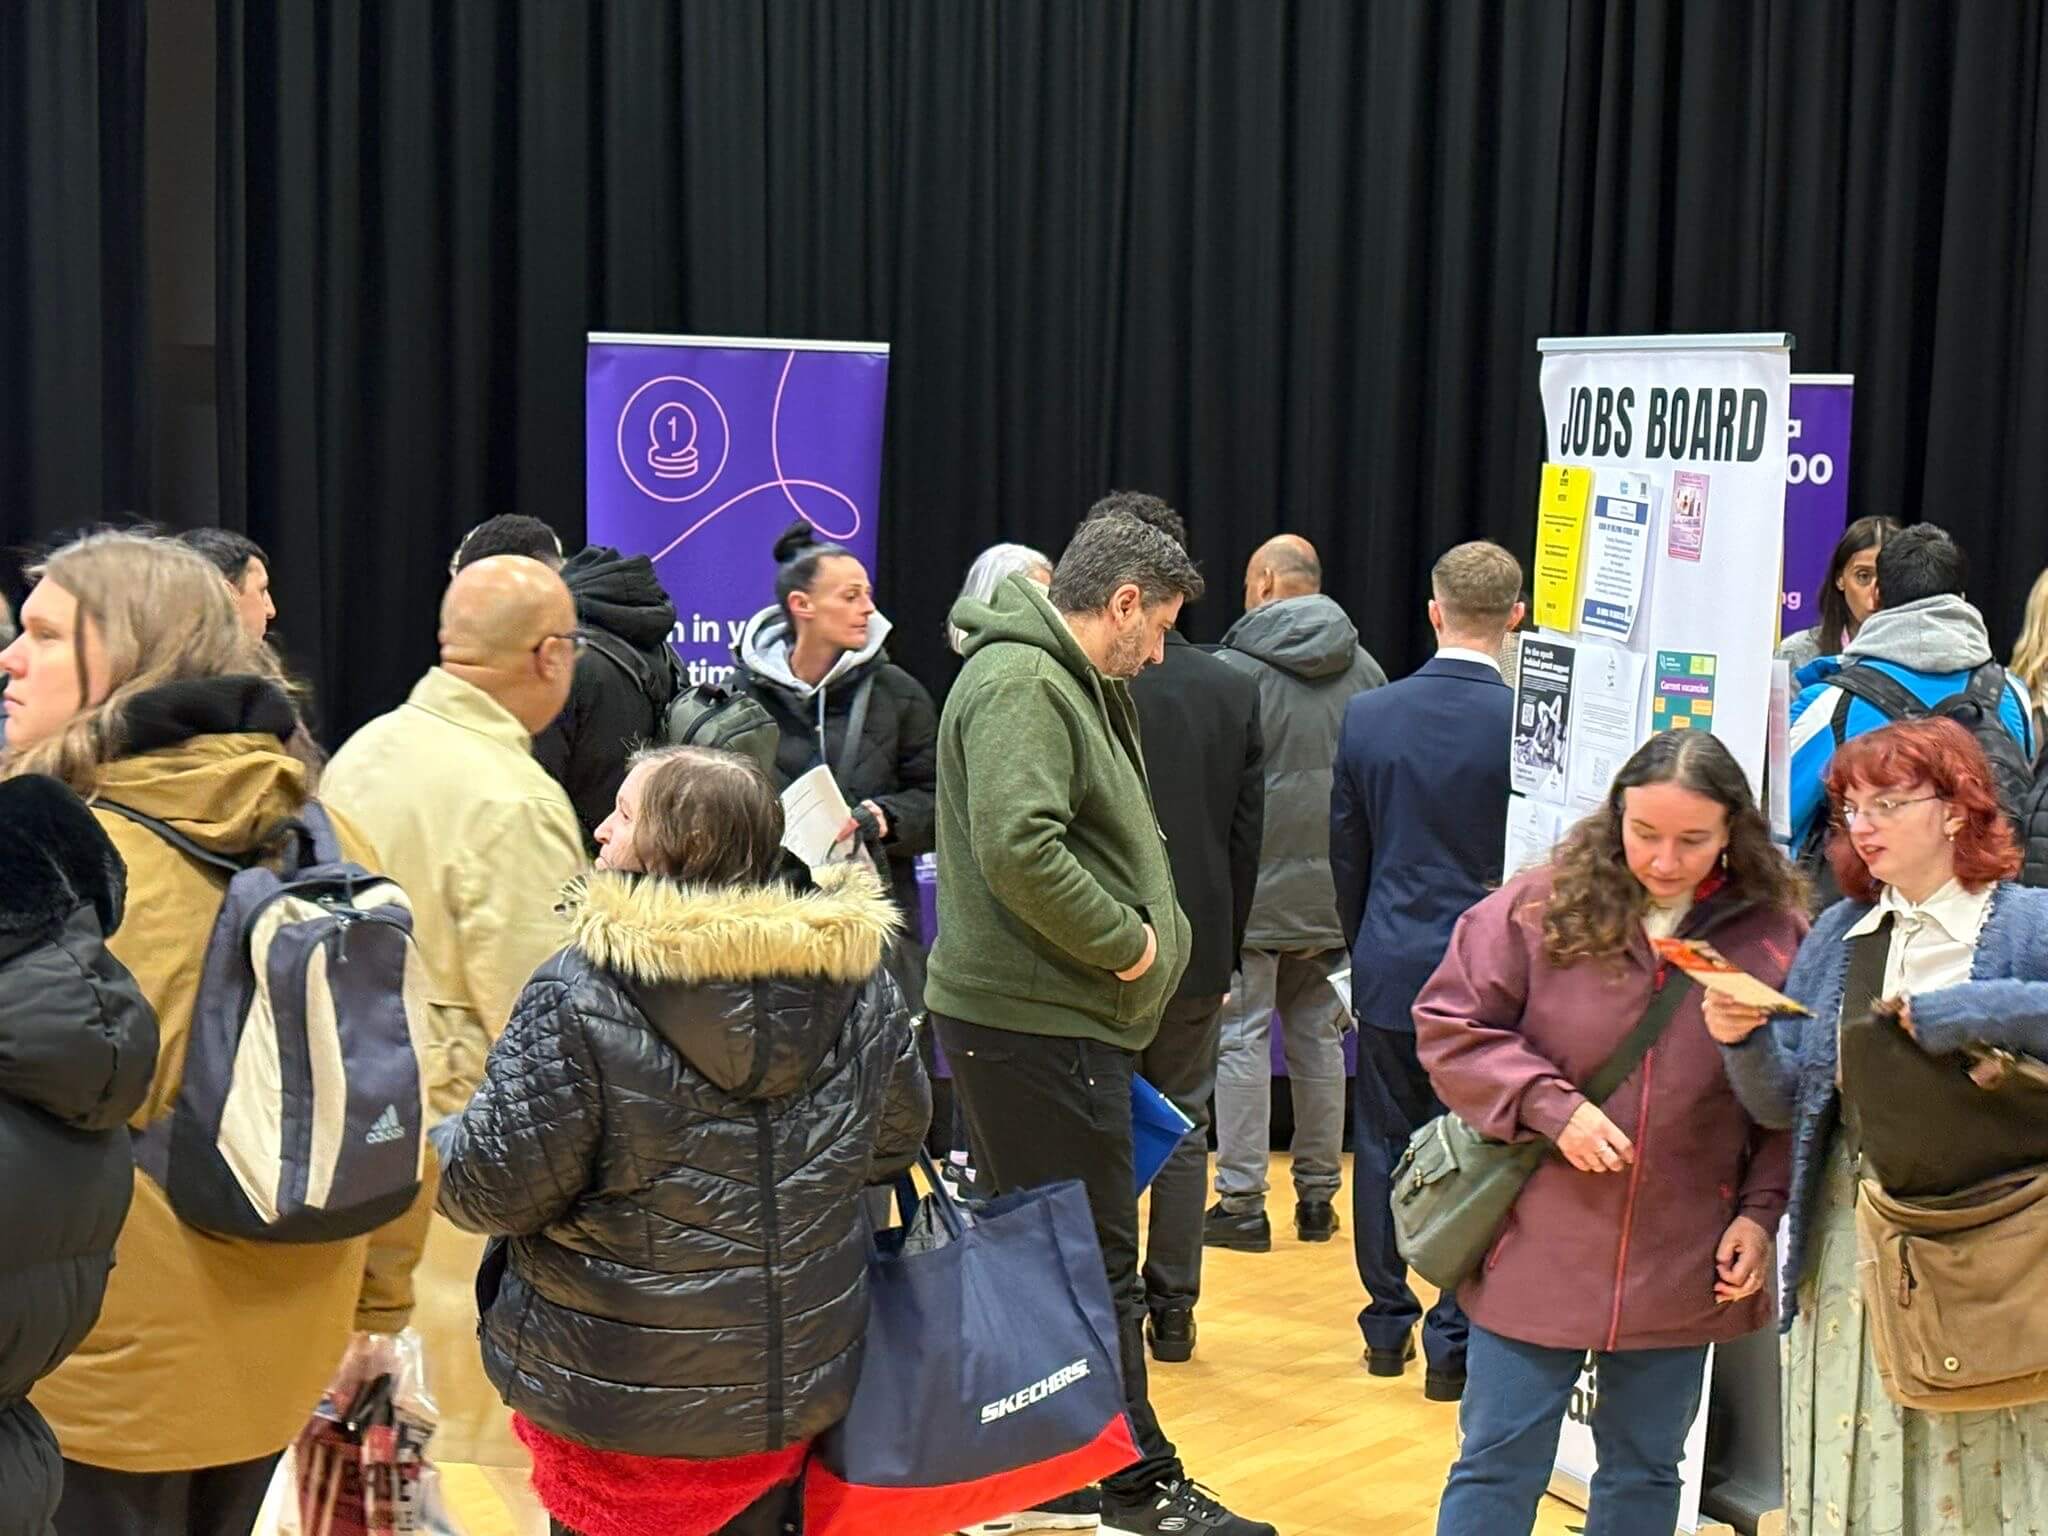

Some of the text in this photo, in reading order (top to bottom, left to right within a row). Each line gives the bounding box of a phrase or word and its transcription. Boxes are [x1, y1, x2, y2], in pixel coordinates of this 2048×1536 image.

[1560, 386, 1768, 462] JOBS BOARD
[693, 613, 720, 643] in
[727, 620, 746, 650] y
[687, 658, 735, 687] tim
[1660, 680, 1709, 694] Current vacancies
[981, 1358, 1088, 1424] SKECHERS
